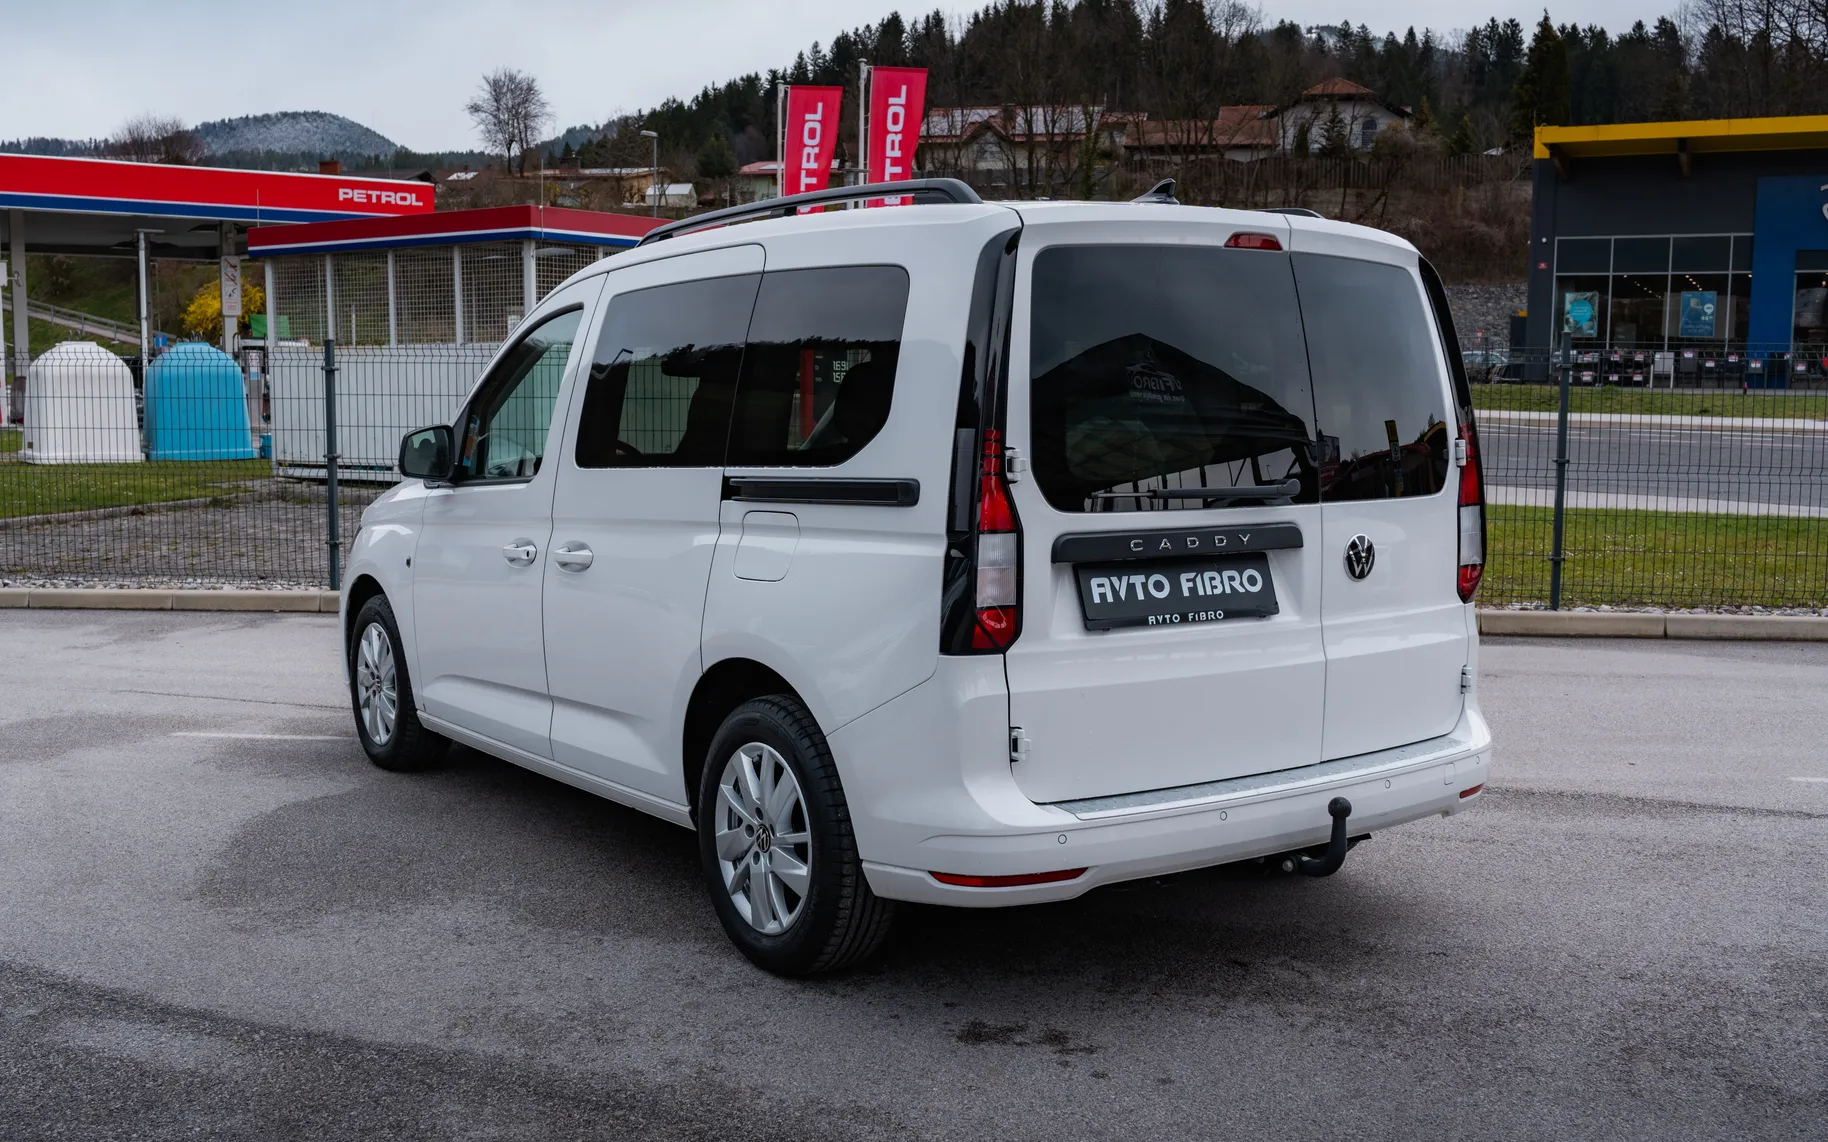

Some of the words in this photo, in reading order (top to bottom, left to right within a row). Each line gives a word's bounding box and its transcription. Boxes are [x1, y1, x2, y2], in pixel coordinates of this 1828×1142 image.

[338, 188, 423, 206] PETROL
[1129, 533, 1251, 552] CADDY
[1090, 573, 1171, 604] AVTO
[1179, 568, 1263, 597] FIBRO
[1188, 610, 1224, 622] FIBRO
